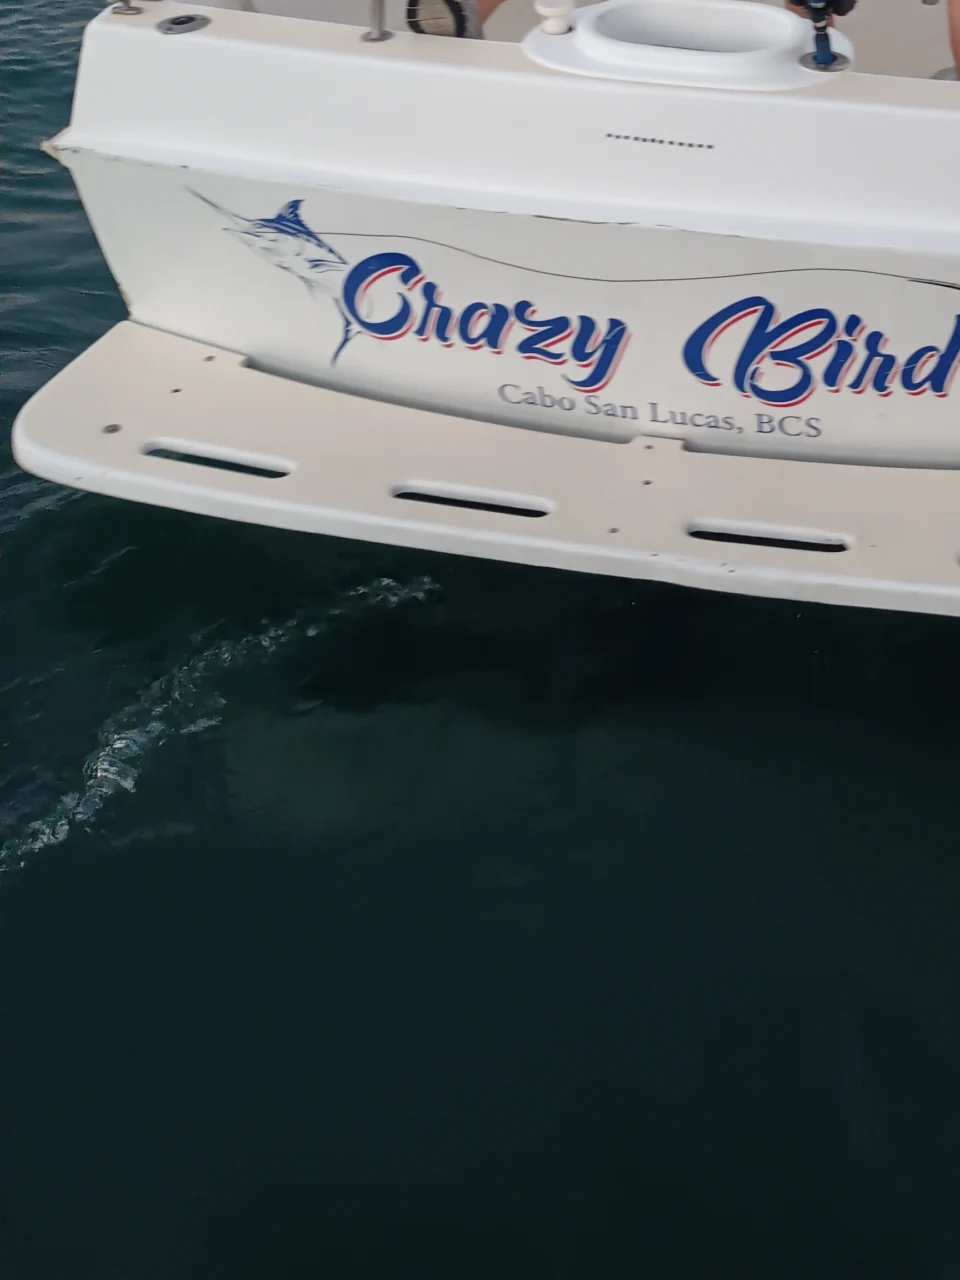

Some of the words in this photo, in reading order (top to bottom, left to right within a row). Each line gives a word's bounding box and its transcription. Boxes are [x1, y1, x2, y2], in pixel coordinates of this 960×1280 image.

[343, 251, 633, 394] Crazy
[497, 382, 577, 412] Cabo
[584, 394, 639, 421] San
[647, 401, 745, 435] Lucas,
[755, 412, 823, 439] BCS
